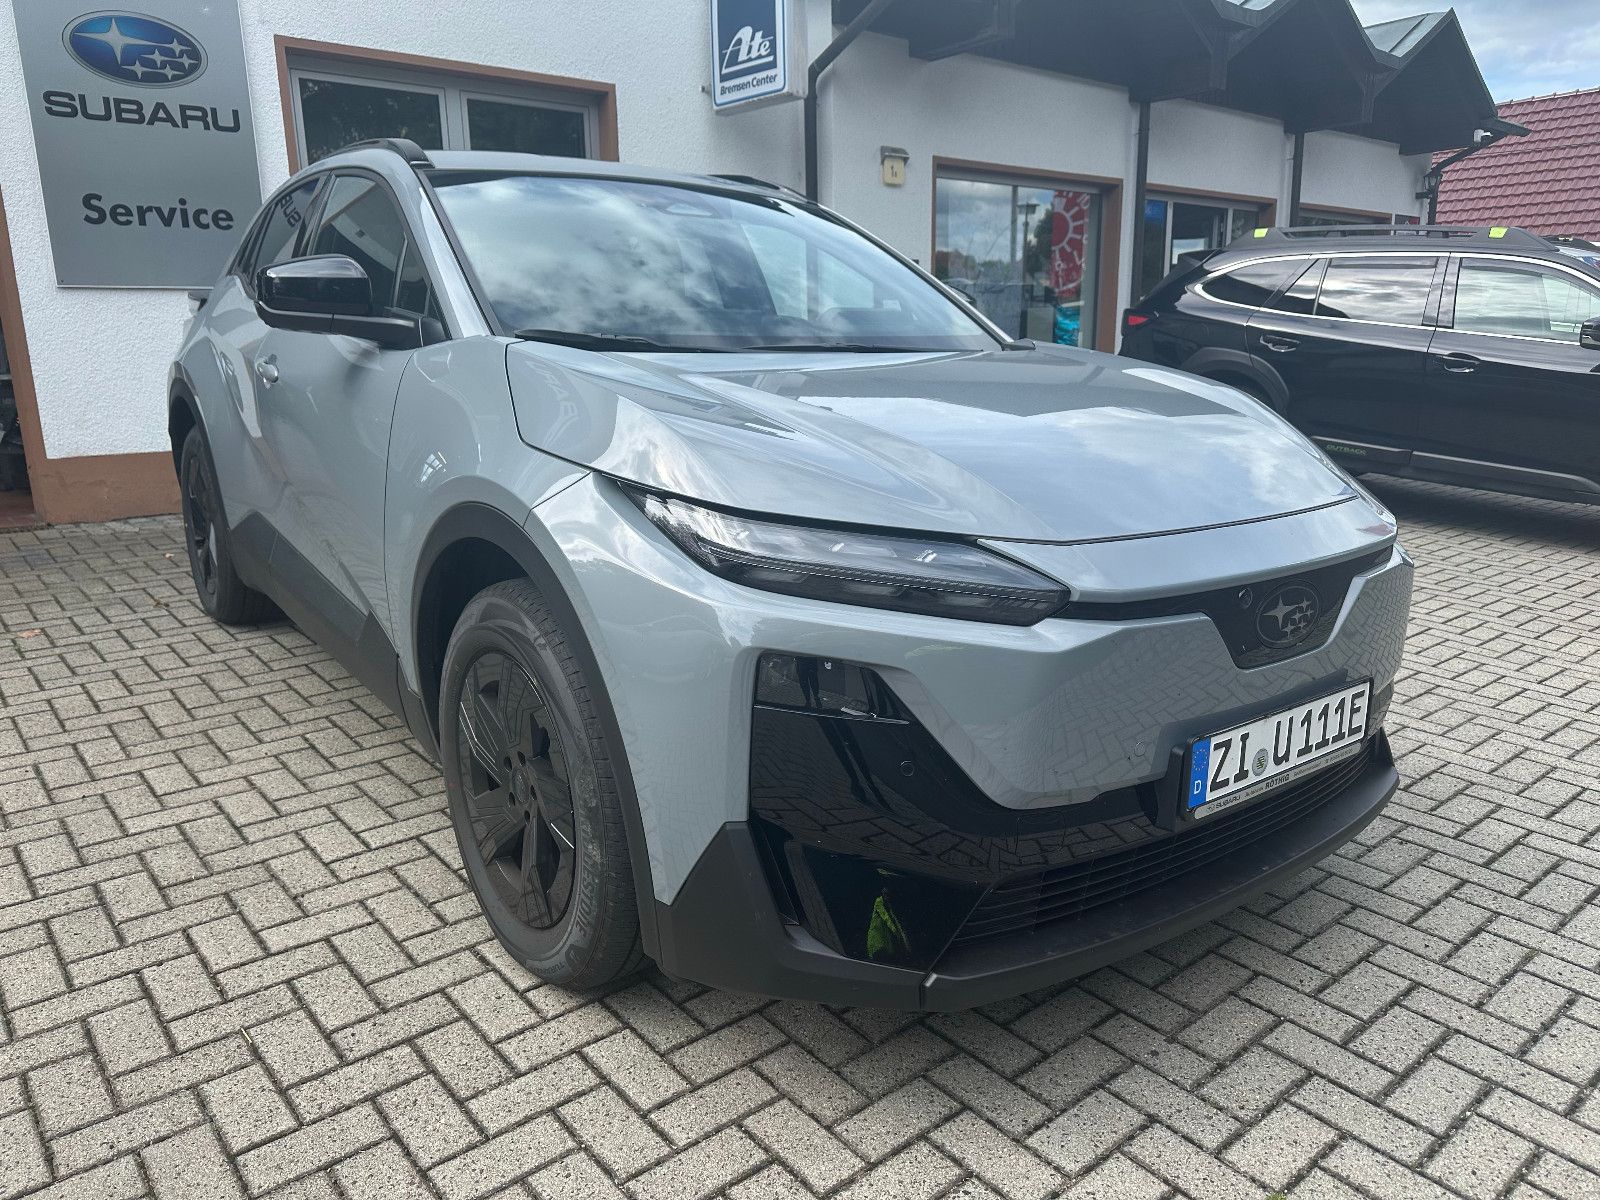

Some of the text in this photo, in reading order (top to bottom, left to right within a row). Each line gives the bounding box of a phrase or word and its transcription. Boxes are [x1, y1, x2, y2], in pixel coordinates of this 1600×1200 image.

[721, 26, 774, 74] Ate
[720, 73, 778, 96] Bremsen Center
[42, 91, 241, 133] SUBARU
[81, 193, 234, 231] Service
[1326, 444, 1368, 456] OUTBACK
[1209, 689, 1366, 793] ZI U111E
[1193, 779, 1202, 795] D
